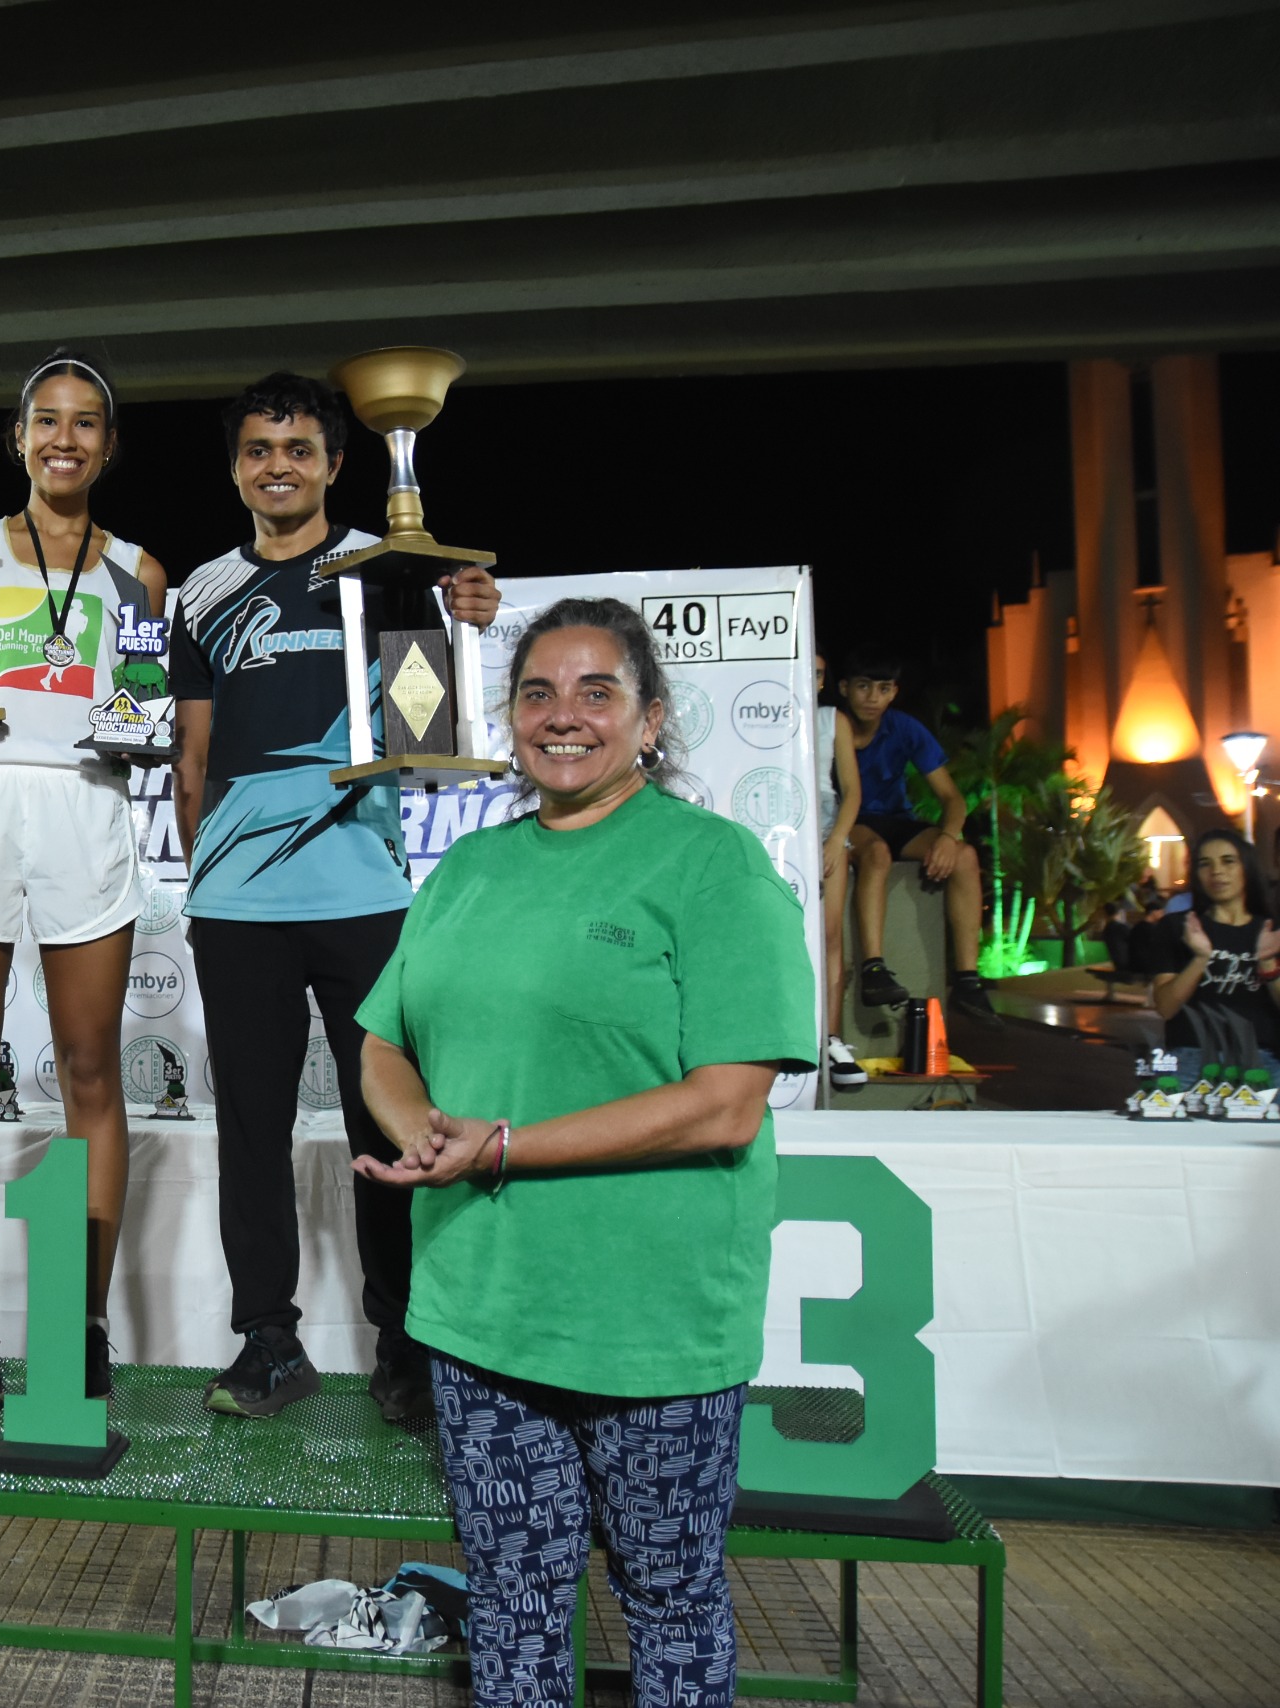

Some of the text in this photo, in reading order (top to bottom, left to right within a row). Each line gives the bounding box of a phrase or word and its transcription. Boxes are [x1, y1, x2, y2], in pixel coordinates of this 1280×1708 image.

[120, 605, 163, 637] 1er
[653, 602, 707, 637] 40
[728, 615, 789, 641] FAyD
[18, 628, 49, 643] Mont
[119, 637, 163, 652] PUESTO
[92, 711, 147, 723] GRAN PRIX
[98, 721, 151, 734] NOCTURNO
[127, 972, 177, 993] mbyá
[165, 1062, 182, 1075] 3er
[3, 1138, 107, 1448] 1
